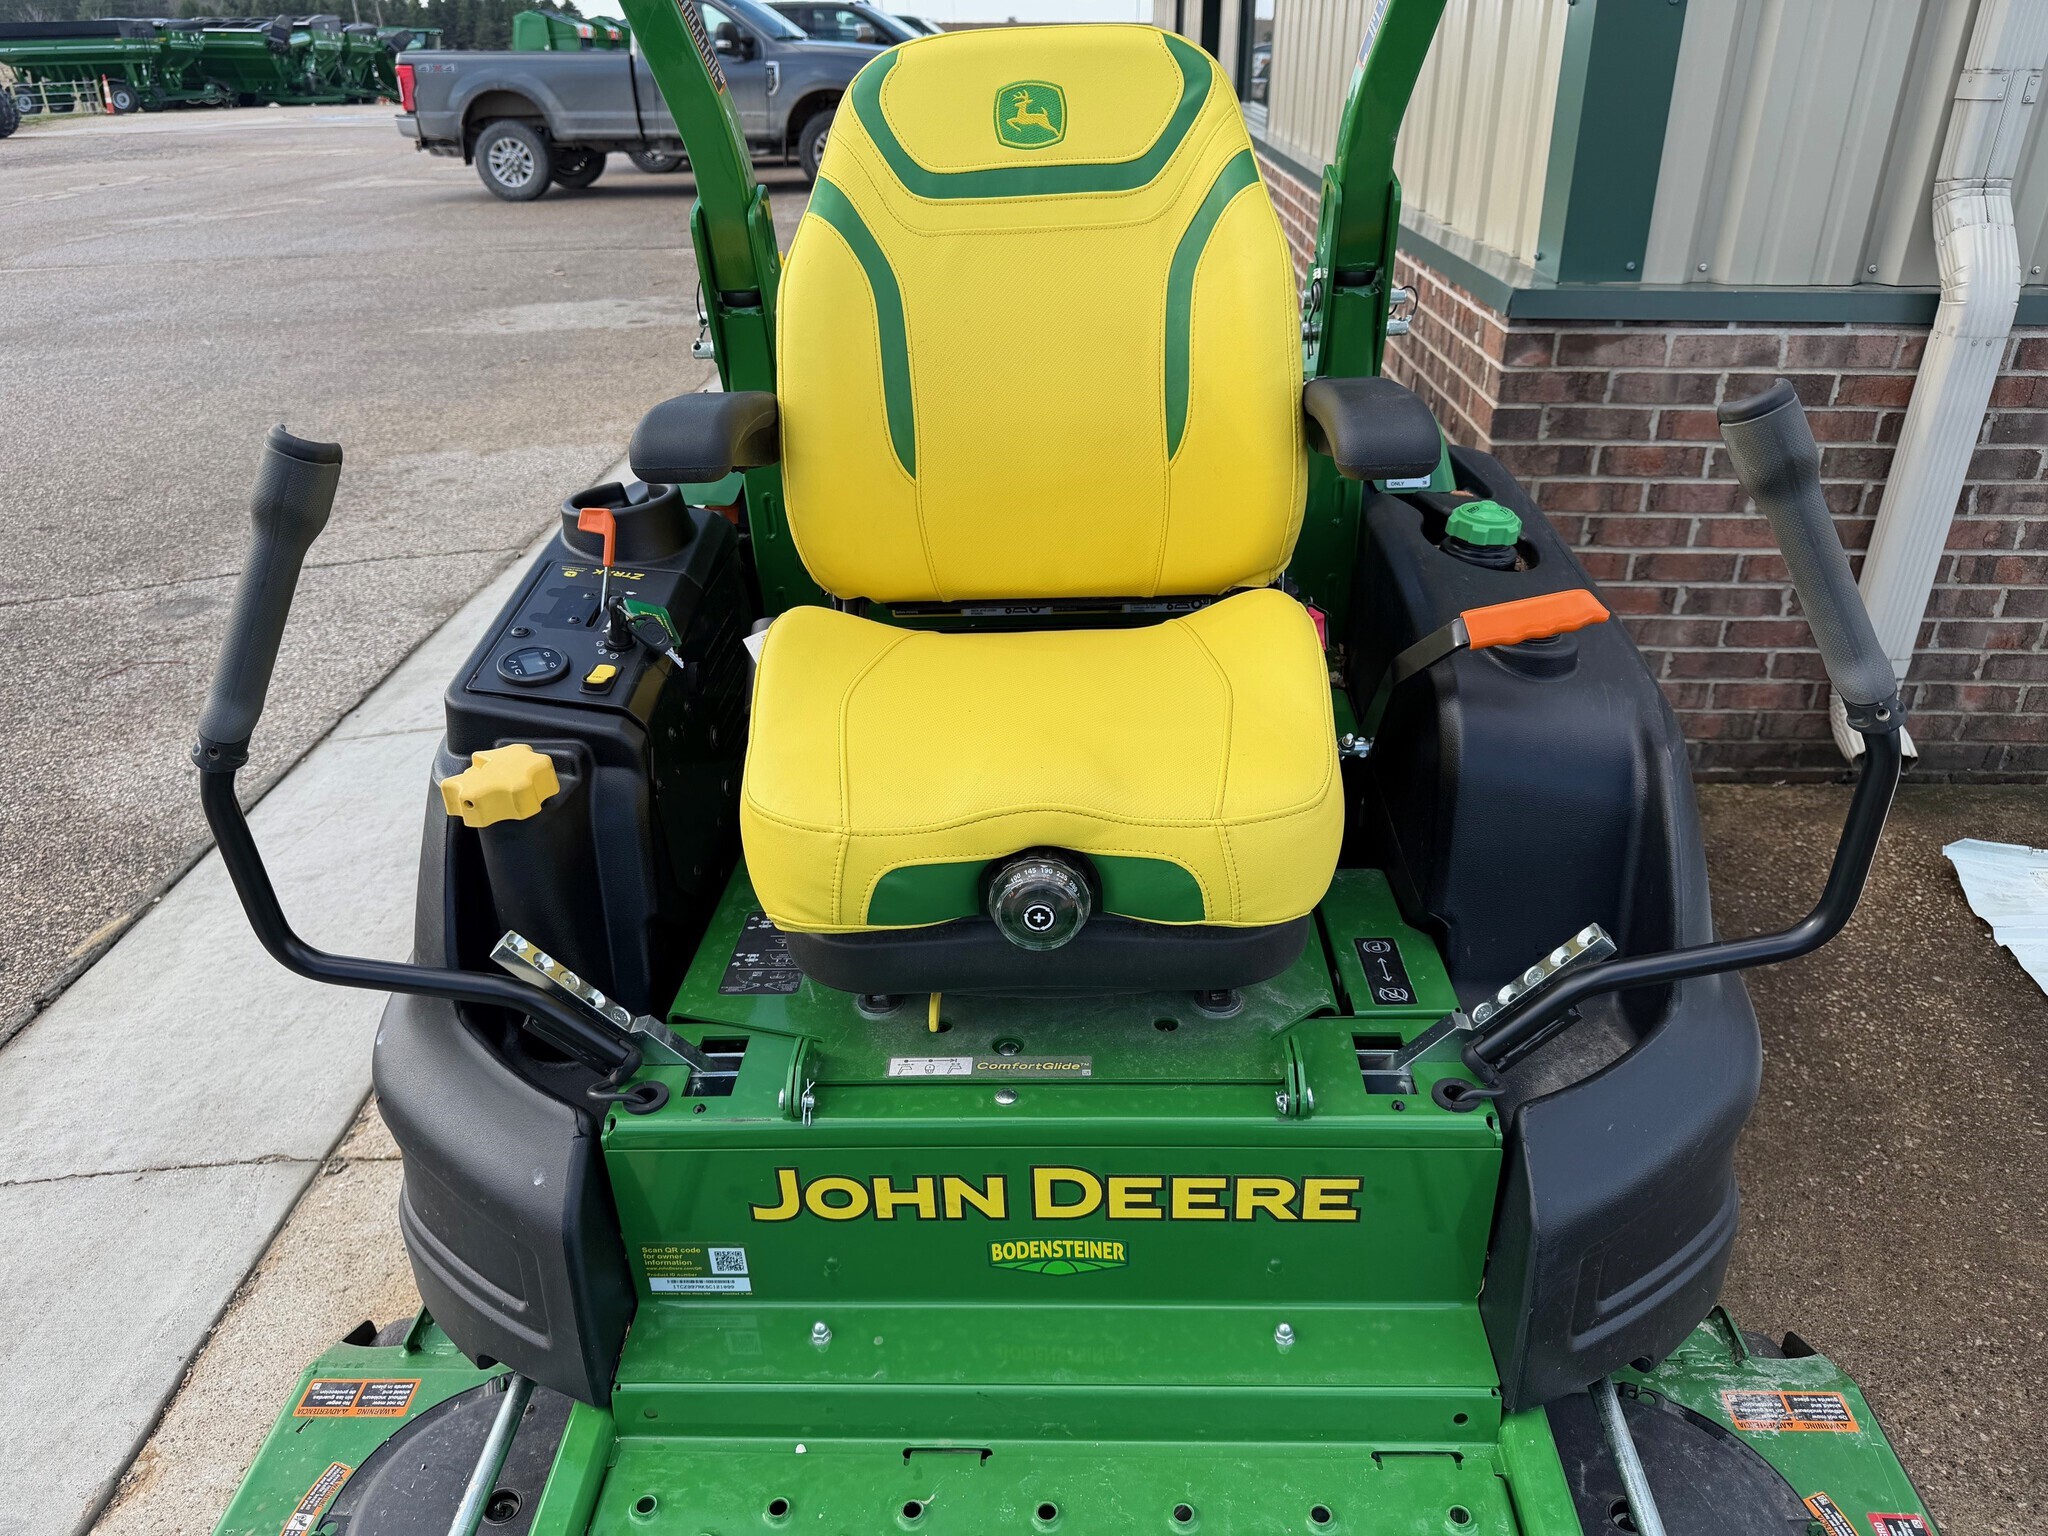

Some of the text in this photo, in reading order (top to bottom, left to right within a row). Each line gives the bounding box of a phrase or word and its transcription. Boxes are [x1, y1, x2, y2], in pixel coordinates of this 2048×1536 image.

[1010, 873, 1022, 884] 100
[1024, 867, 1037, 875] 145
[1040, 867, 1053, 875] 190
[751, 1166, 1363, 1222] JOHN DEERE
[991, 1240, 1125, 1261] BODENSTEINER
